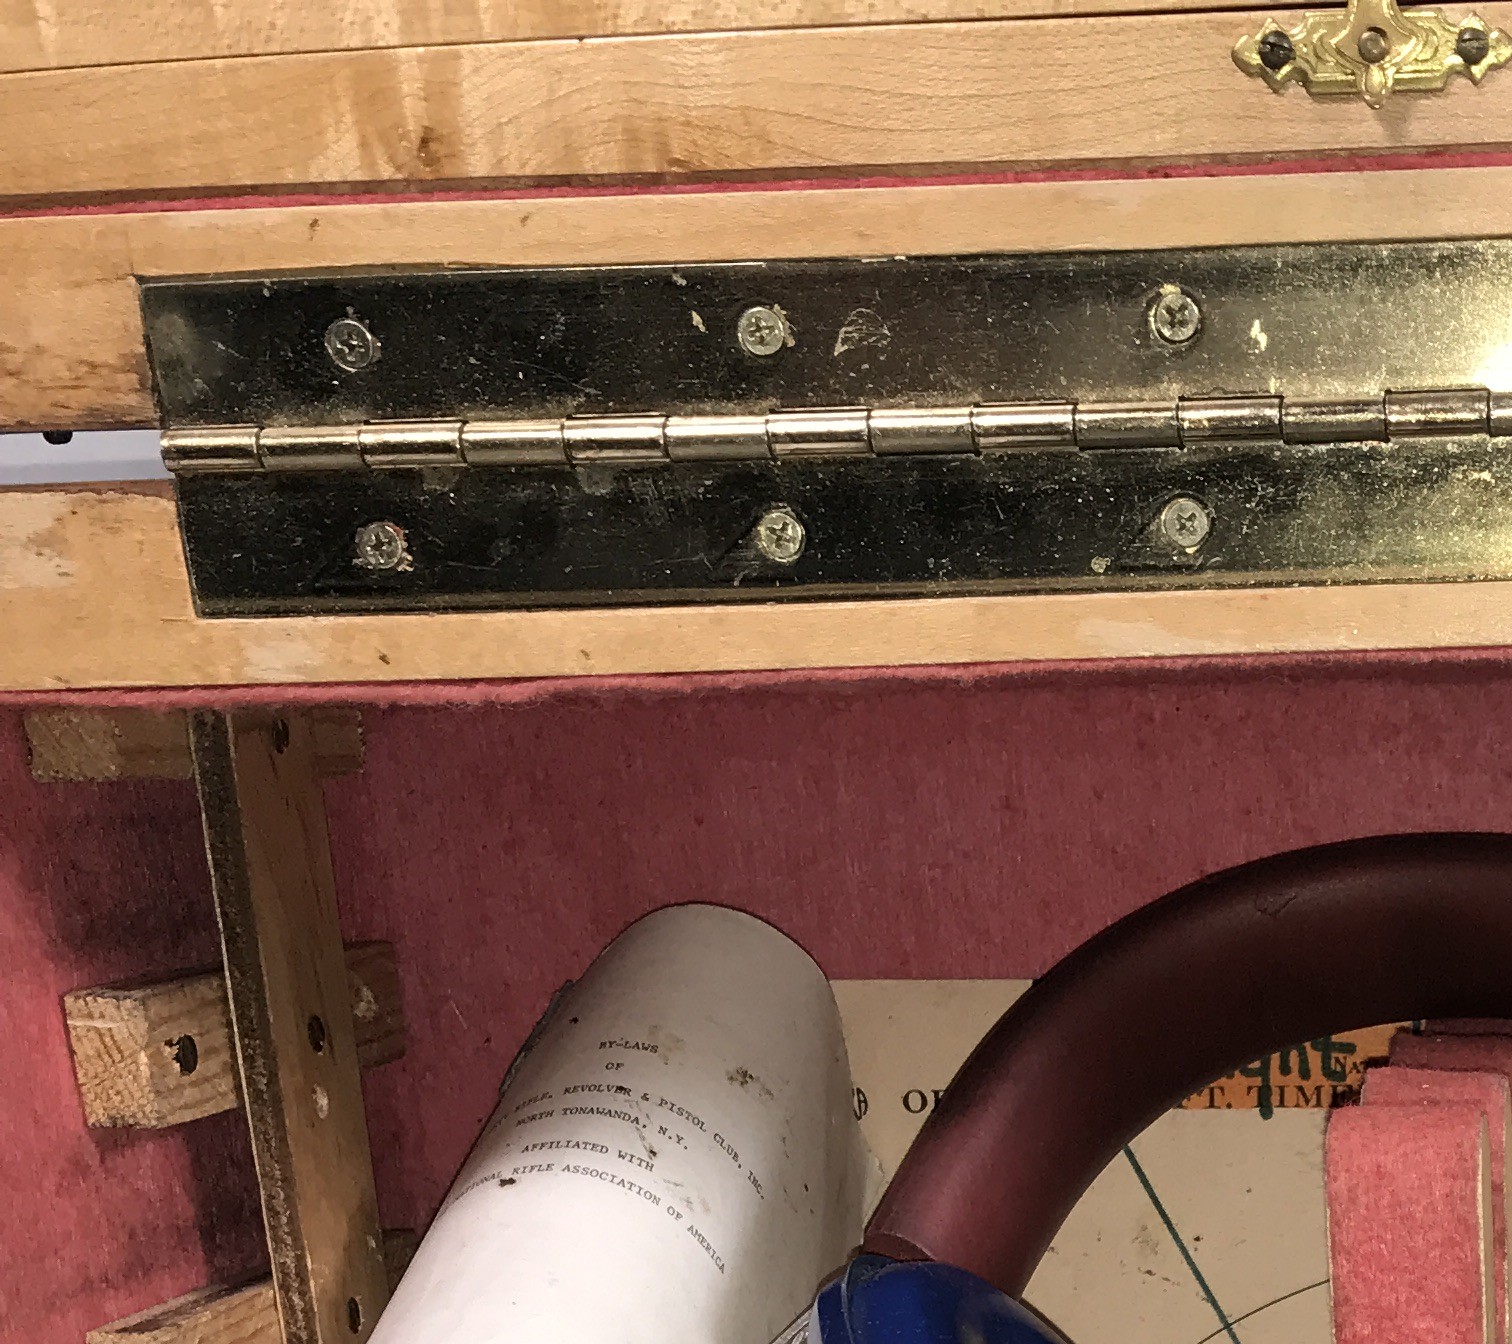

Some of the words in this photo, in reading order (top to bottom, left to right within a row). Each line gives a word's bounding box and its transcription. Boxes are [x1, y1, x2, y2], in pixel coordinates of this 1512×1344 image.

[599, 1039, 659, 1054] BY-LAWS
[605, 1062, 625, 1071] OF
[562, 1084, 632, 1097] REVOLVER
[641, 1092, 650, 1102] &
[658, 1097, 707, 1133] PISTOL
[515, 1110, 555, 1127] NORTH
[657, 1125, 689, 1151] N.Y.
[520, 1140, 610, 1154] AFFILIATED
[617, 1150, 655, 1173] WITH
[512, 1163, 555, 1176] RIFLE
[562, 1163, 661, 1206] ASSOCIATION
[666, 1205, 684, 1222] OF
[687, 1224, 726, 1275] AMERICA
